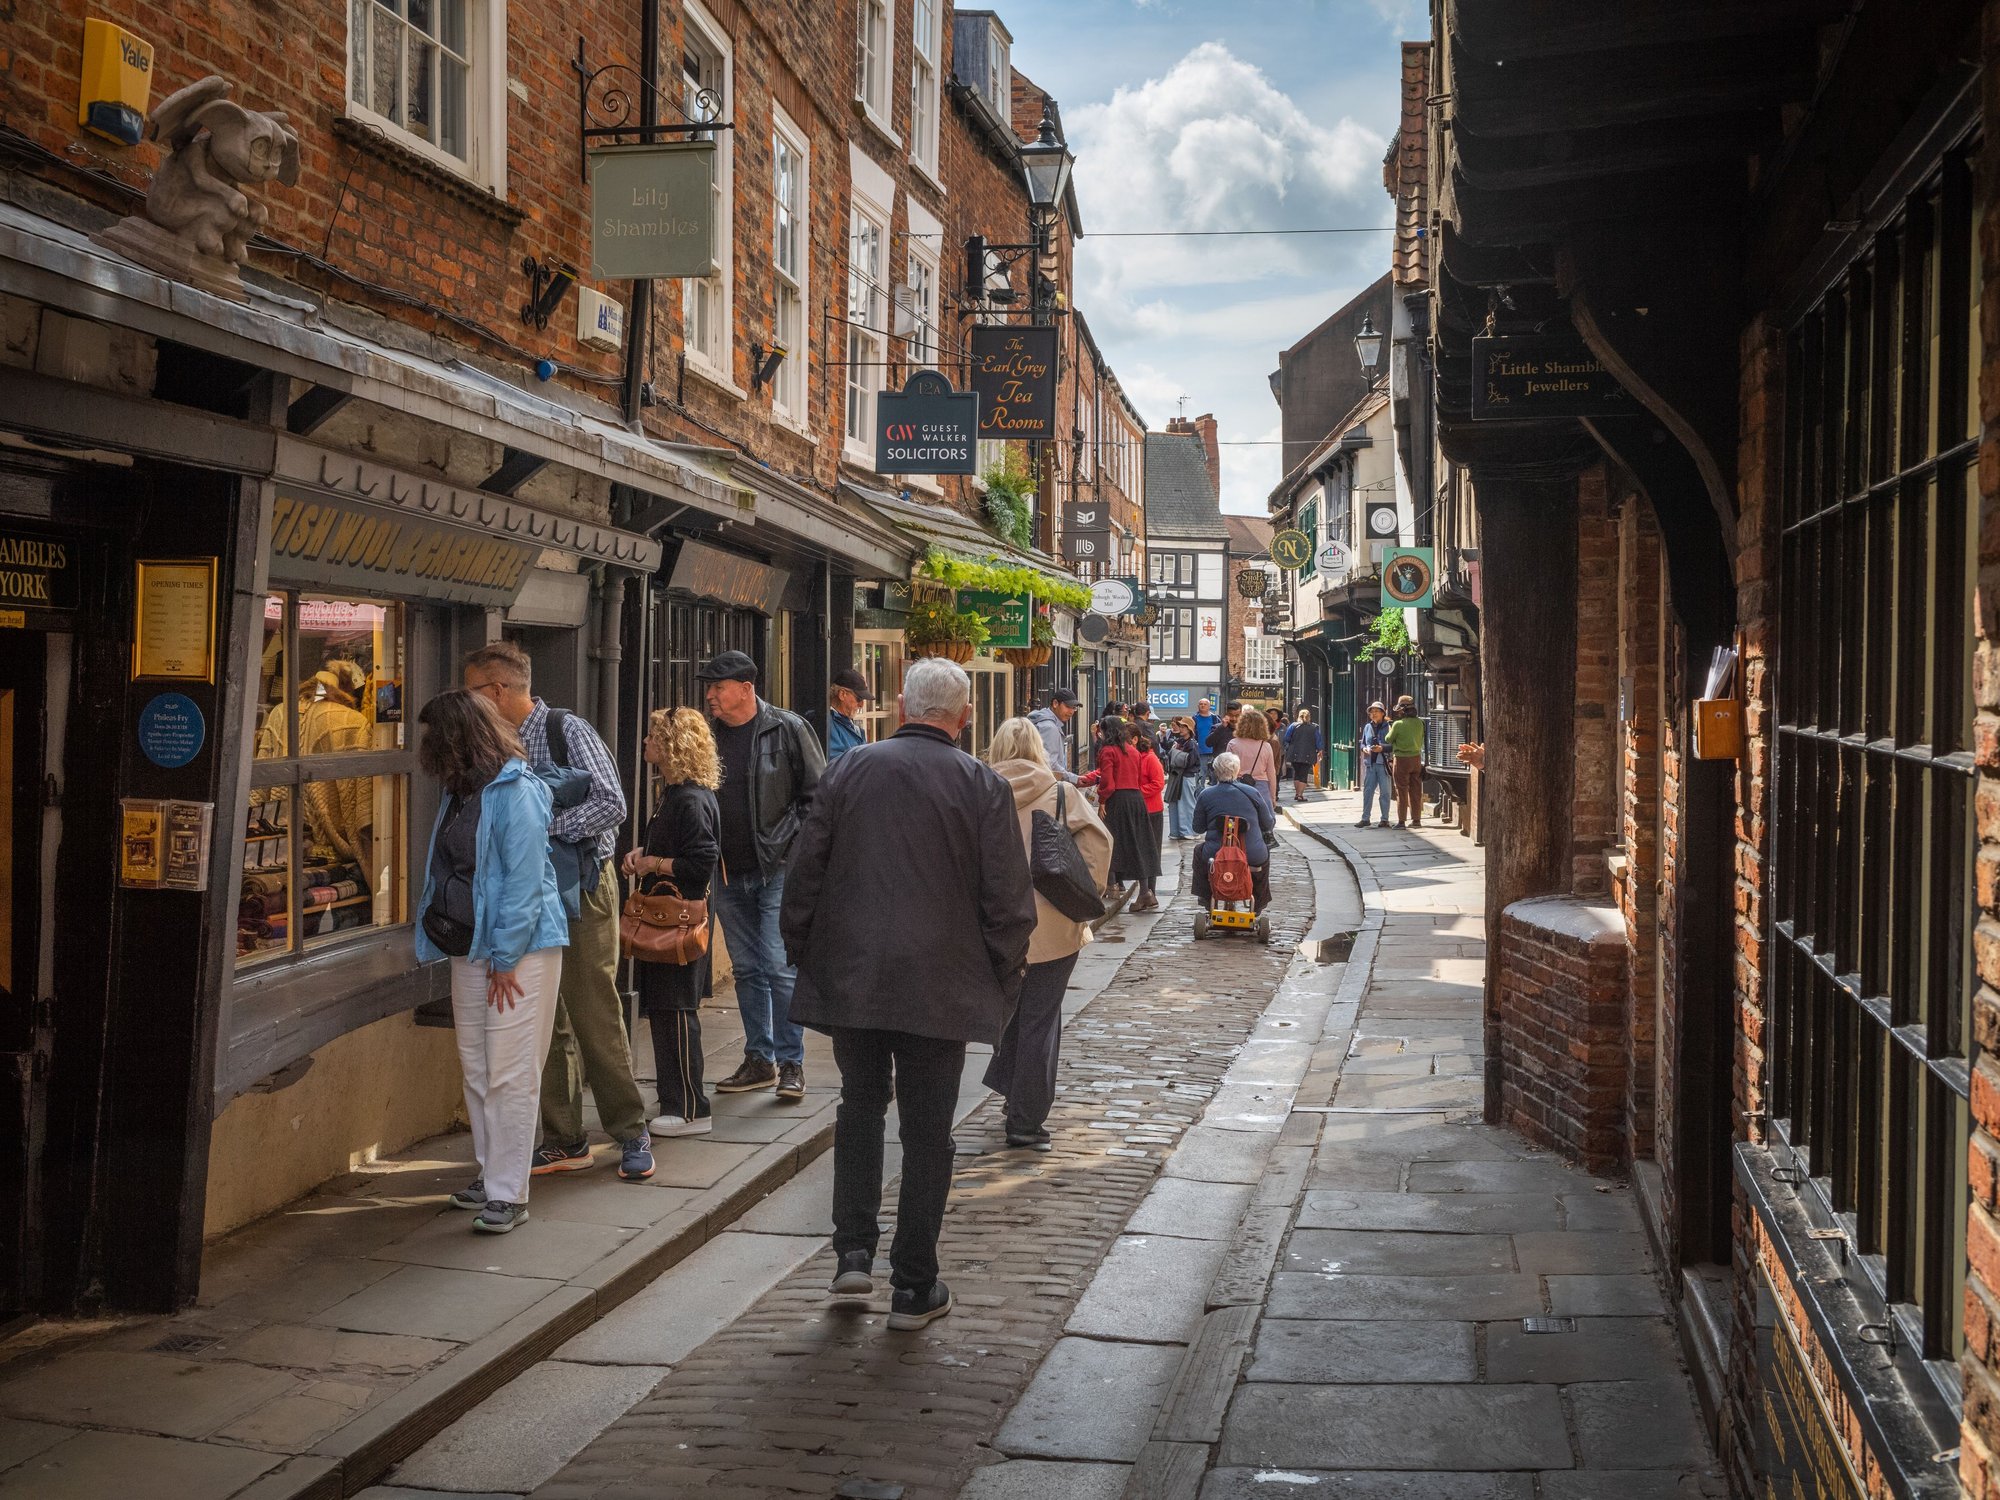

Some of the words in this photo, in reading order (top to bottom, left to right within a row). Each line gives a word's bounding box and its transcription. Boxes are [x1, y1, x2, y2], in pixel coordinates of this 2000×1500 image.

[121, 39, 149, 72] Yale
[632, 188, 668, 210] Lily
[602, 218, 699, 238] Shambles
[1004, 337, 1025, 351] The
[982, 353, 1014, 373] Earl
[1011, 355, 1047, 379] Grey
[1501, 362, 1539, 376] Little
[1544, 360, 1606, 374] Shamble
[919, 381, 941, 395] 12A
[996, 380, 1033, 404] Tea
[1525, 379, 1589, 396] Jewellers
[980, 406, 1045, 430] Rooms
[922, 424, 959, 432] GUEST
[922, 434, 967, 442] WALKER
[887, 448, 968, 460] SOLICITORS
[271, 496, 339, 564] TISH
[326, 511, 403, 572] WOOL
[414, 530, 534, 592] CASHMERE
[0, 537, 66, 569] AMBLES
[0, 571, 48, 600] YORK
[150, 581, 181, 589] OPENING
[182, 581, 204, 589] TIMES
[976, 602, 1006, 617] Tea
[986, 620, 1020, 637] den
[1147, 693, 1186, 705] REGGS
[177, 714, 189, 723] Fry
